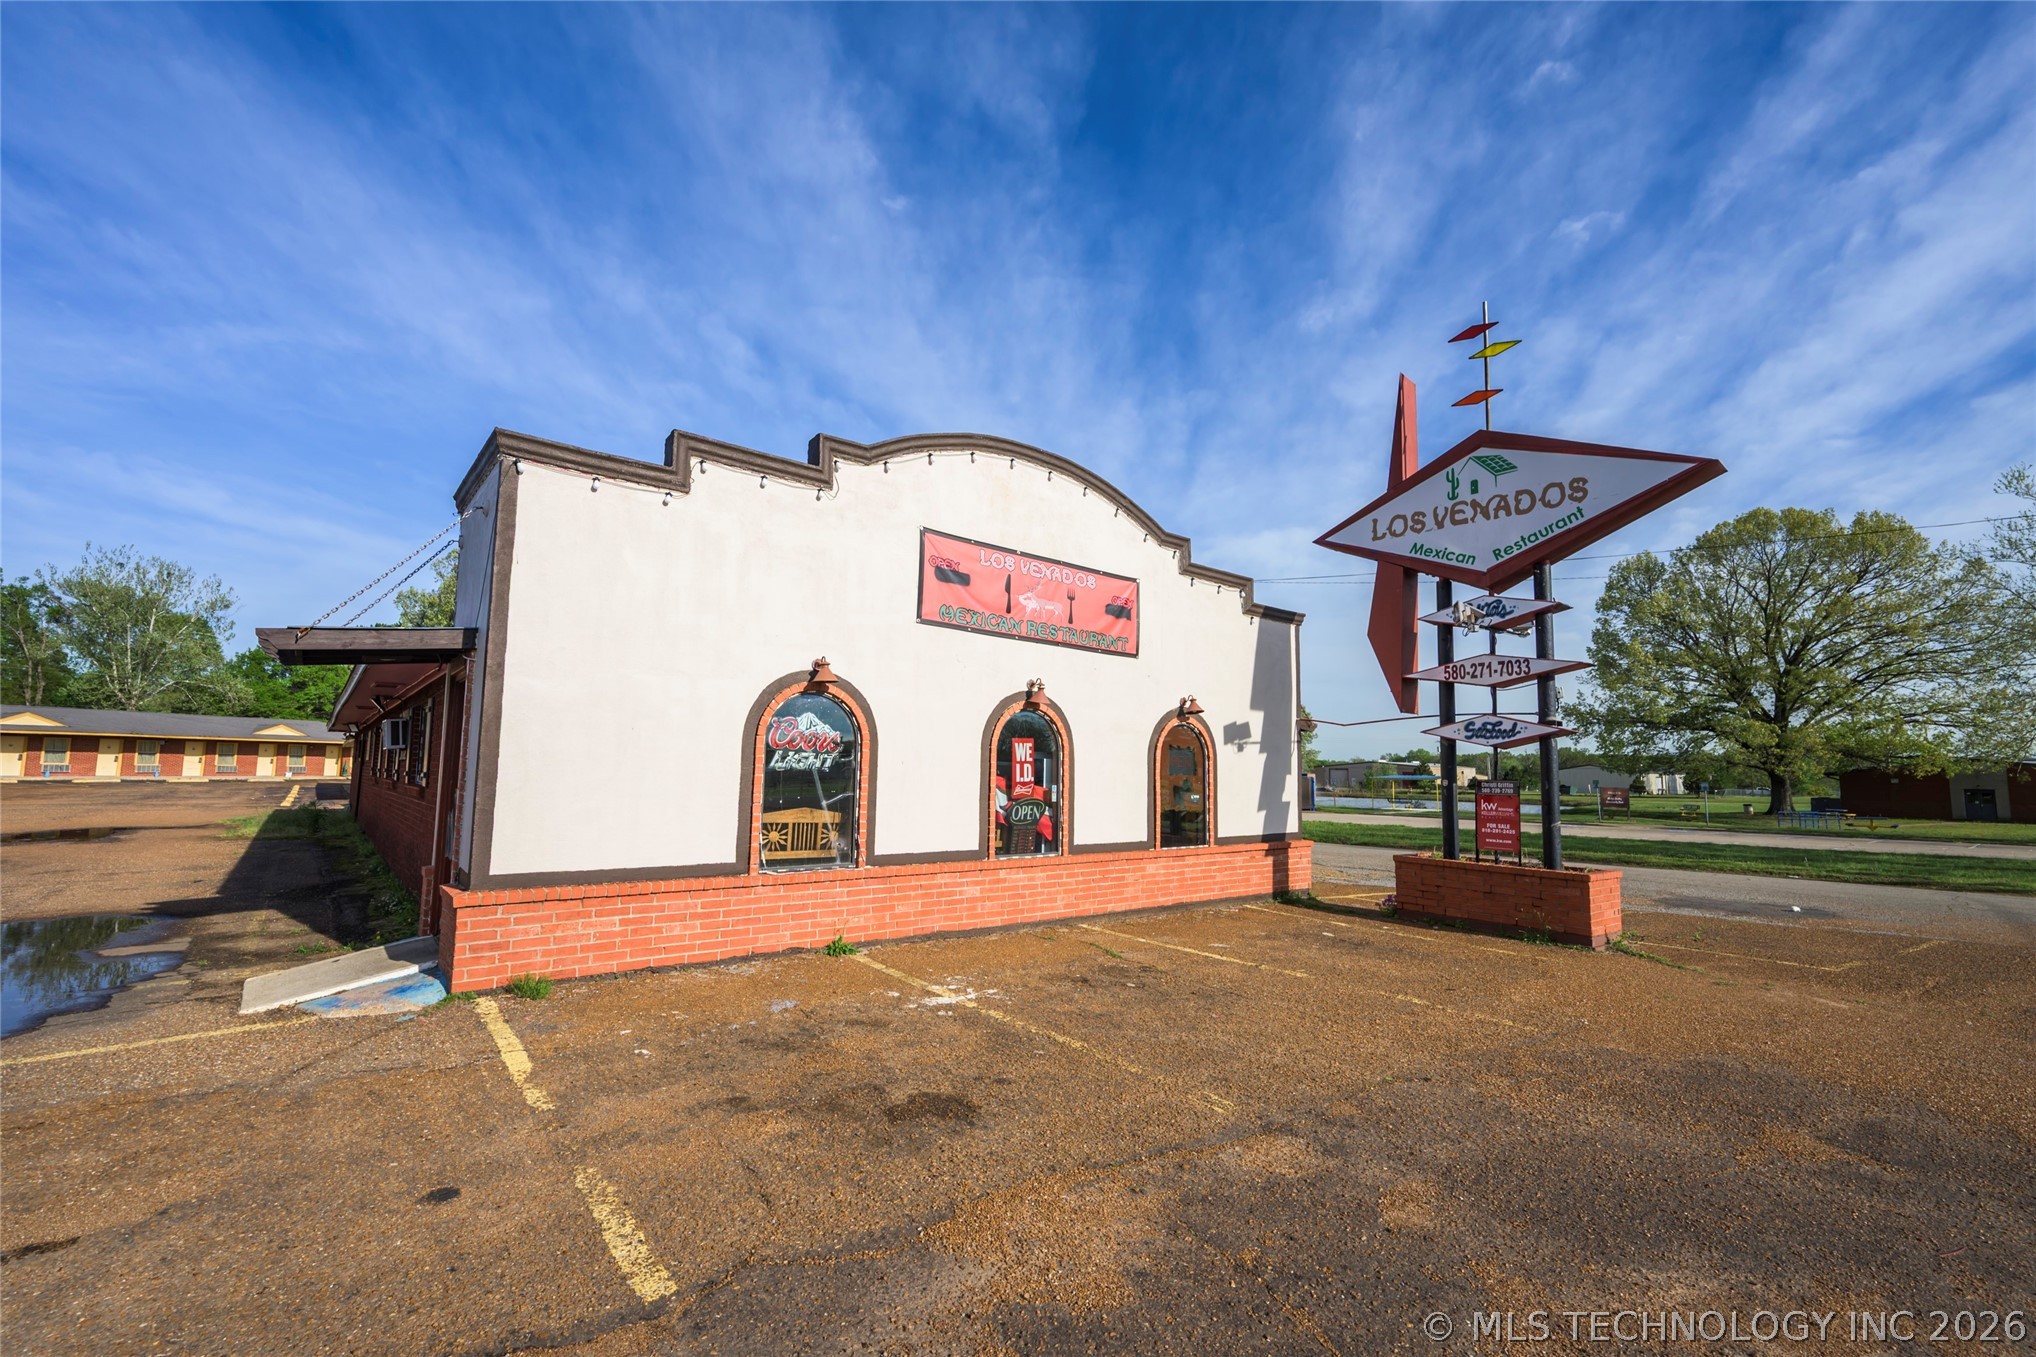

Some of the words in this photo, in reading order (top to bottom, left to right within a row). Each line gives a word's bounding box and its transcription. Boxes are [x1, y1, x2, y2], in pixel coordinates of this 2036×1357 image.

[1371, 510, 1427, 542] LOS
[1433, 477, 1589, 530] VENADOS
[1409, 542, 1476, 566] Mexican
[1492, 505, 1585, 561] Restaurant
[979, 549, 1016, 572] LOS
[1020, 558, 1097, 590] VENADOS
[939, 604, 1024, 635] MEXICAN
[1026, 622, 1129, 651] RESTAURANT
[1443, 658, 1532, 681] 580-271-7033
[768, 716, 843, 752] Coors
[768, 750, 838, 772] LIGHT
[1014, 742, 1033, 762] WE
[1015, 763, 1035, 782] I.D.
[1012, 805, 1041, 820] OPEN
[1481, 799, 1498, 810] kw
